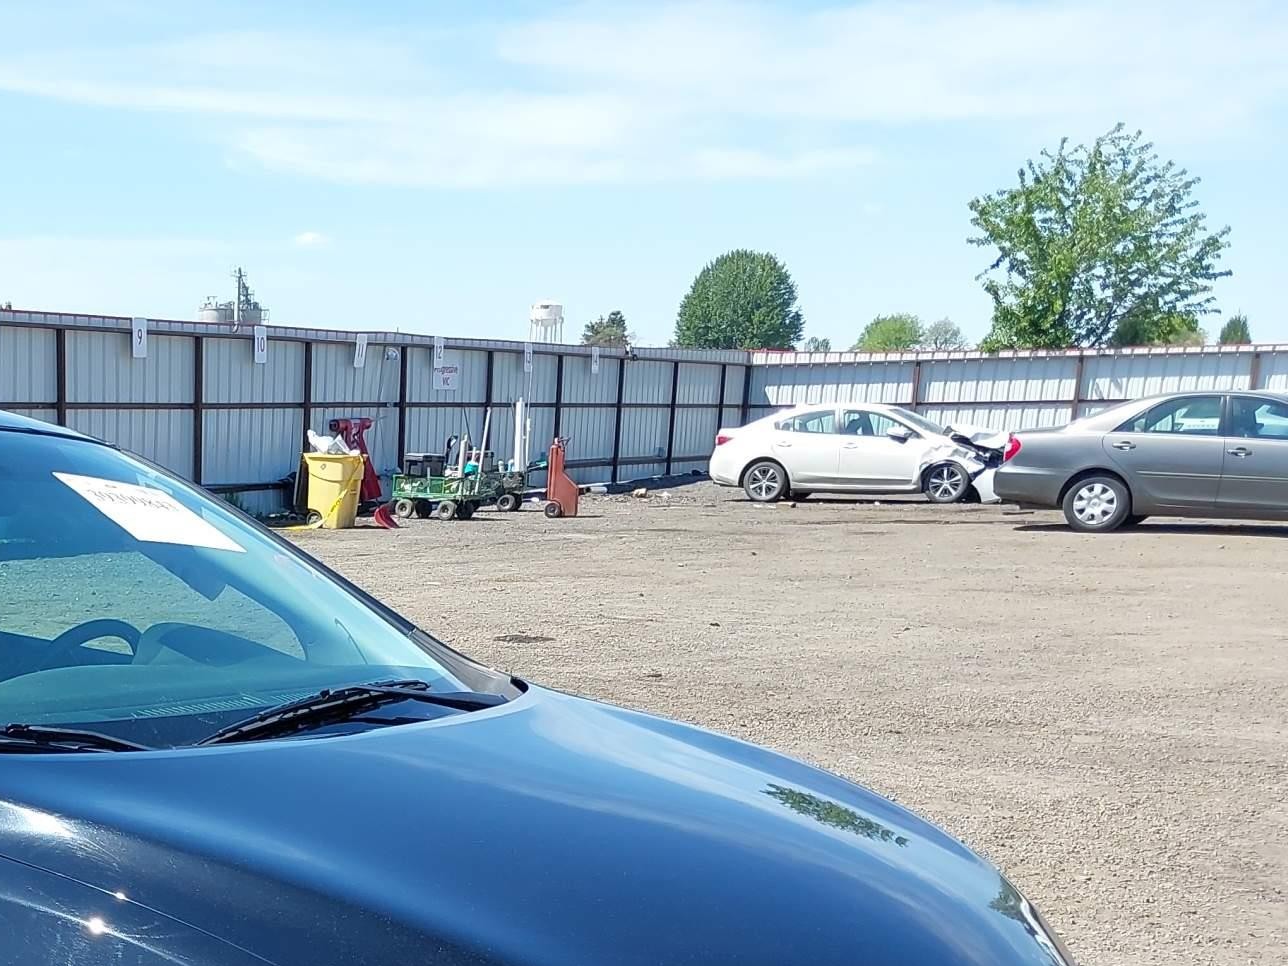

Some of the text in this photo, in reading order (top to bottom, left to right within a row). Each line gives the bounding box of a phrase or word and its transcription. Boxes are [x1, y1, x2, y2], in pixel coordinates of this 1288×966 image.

[137, 328, 143, 345] 9
[256, 336, 265, 353] 10
[357, 343, 365, 359] 11
[435, 345, 443, 360] 12
